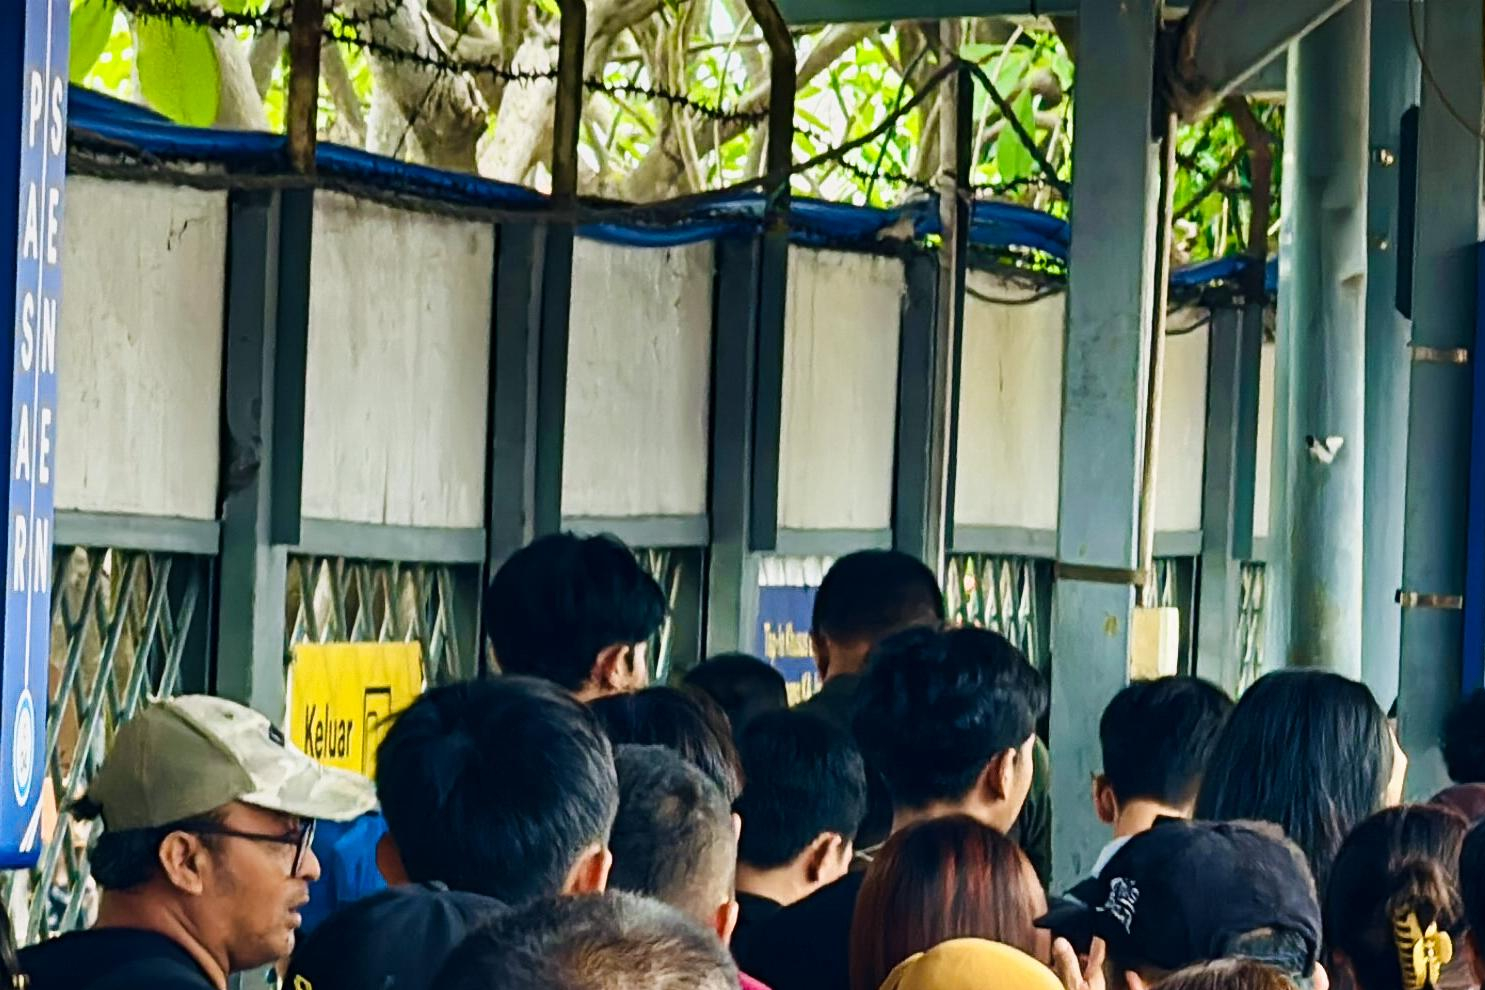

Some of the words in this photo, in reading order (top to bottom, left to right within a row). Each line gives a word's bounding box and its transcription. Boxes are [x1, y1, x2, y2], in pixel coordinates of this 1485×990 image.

[12, 69, 43, 593] PASAR
[33, 75, 63, 595] SENEN
[304, 703, 353, 759] Keluar
